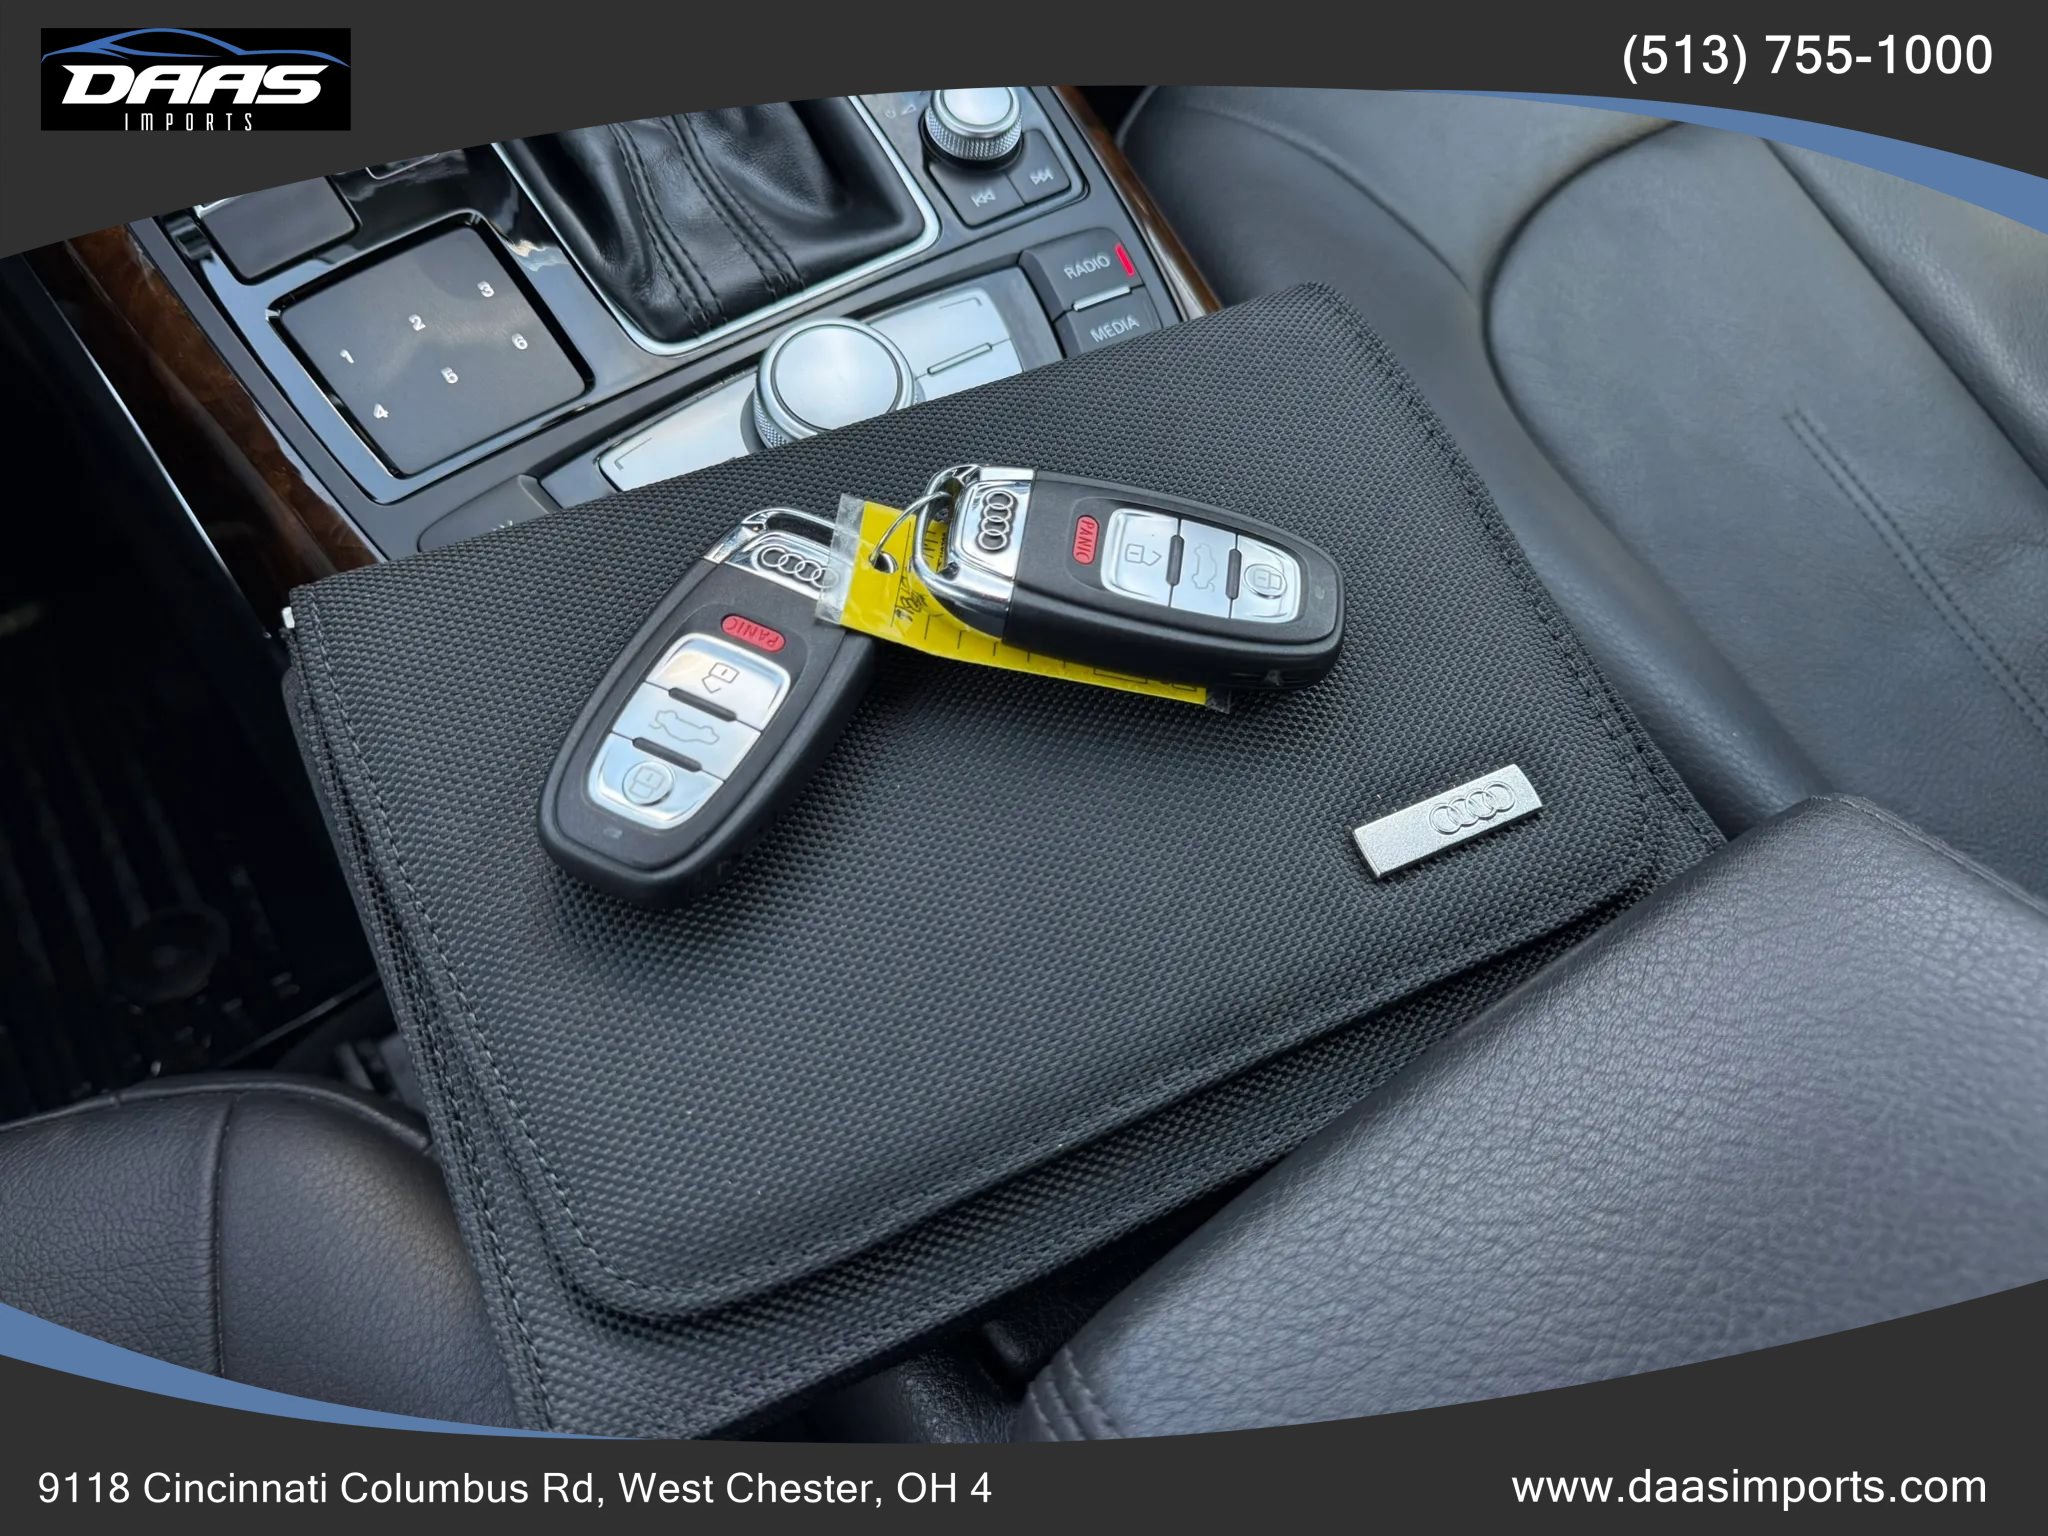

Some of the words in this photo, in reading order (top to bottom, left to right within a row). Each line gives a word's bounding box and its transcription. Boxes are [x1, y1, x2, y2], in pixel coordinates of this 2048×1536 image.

[1063, 253, 1111, 279] RADIO
[339, 349, 355, 364] 1
[408, 314, 426, 331] 2
[477, 280, 495, 298] 3
[1089, 315, 1140, 343] MEDIA
[373, 403, 389, 419] 4
[441, 367, 459, 384] 5
[511, 333, 528, 350] 6
[1075, 519, 1096, 561] PANIC
[725, 617, 780, 648] PANIC
